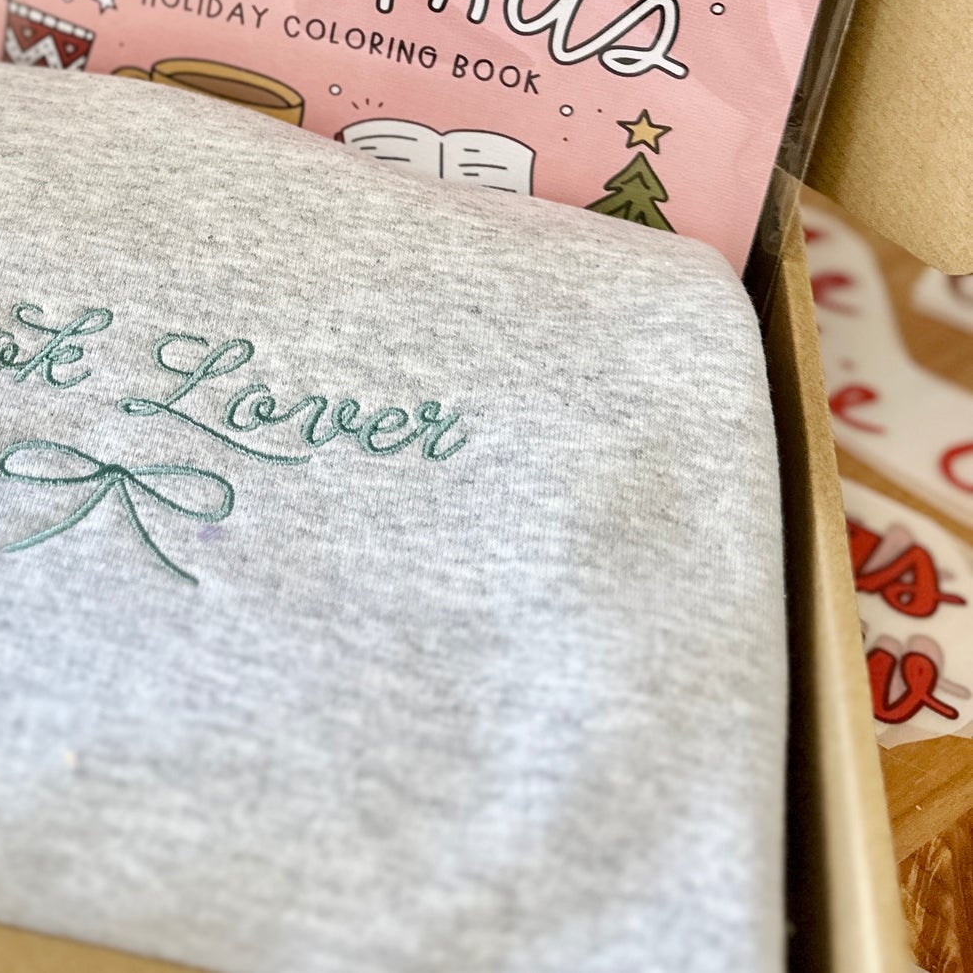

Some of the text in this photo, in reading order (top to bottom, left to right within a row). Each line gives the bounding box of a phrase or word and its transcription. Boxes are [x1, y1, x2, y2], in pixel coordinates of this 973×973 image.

[284, 15, 437, 69] COLORING
[452, 54, 541, 94] BOOK
[116, 331, 468, 465] Lover
